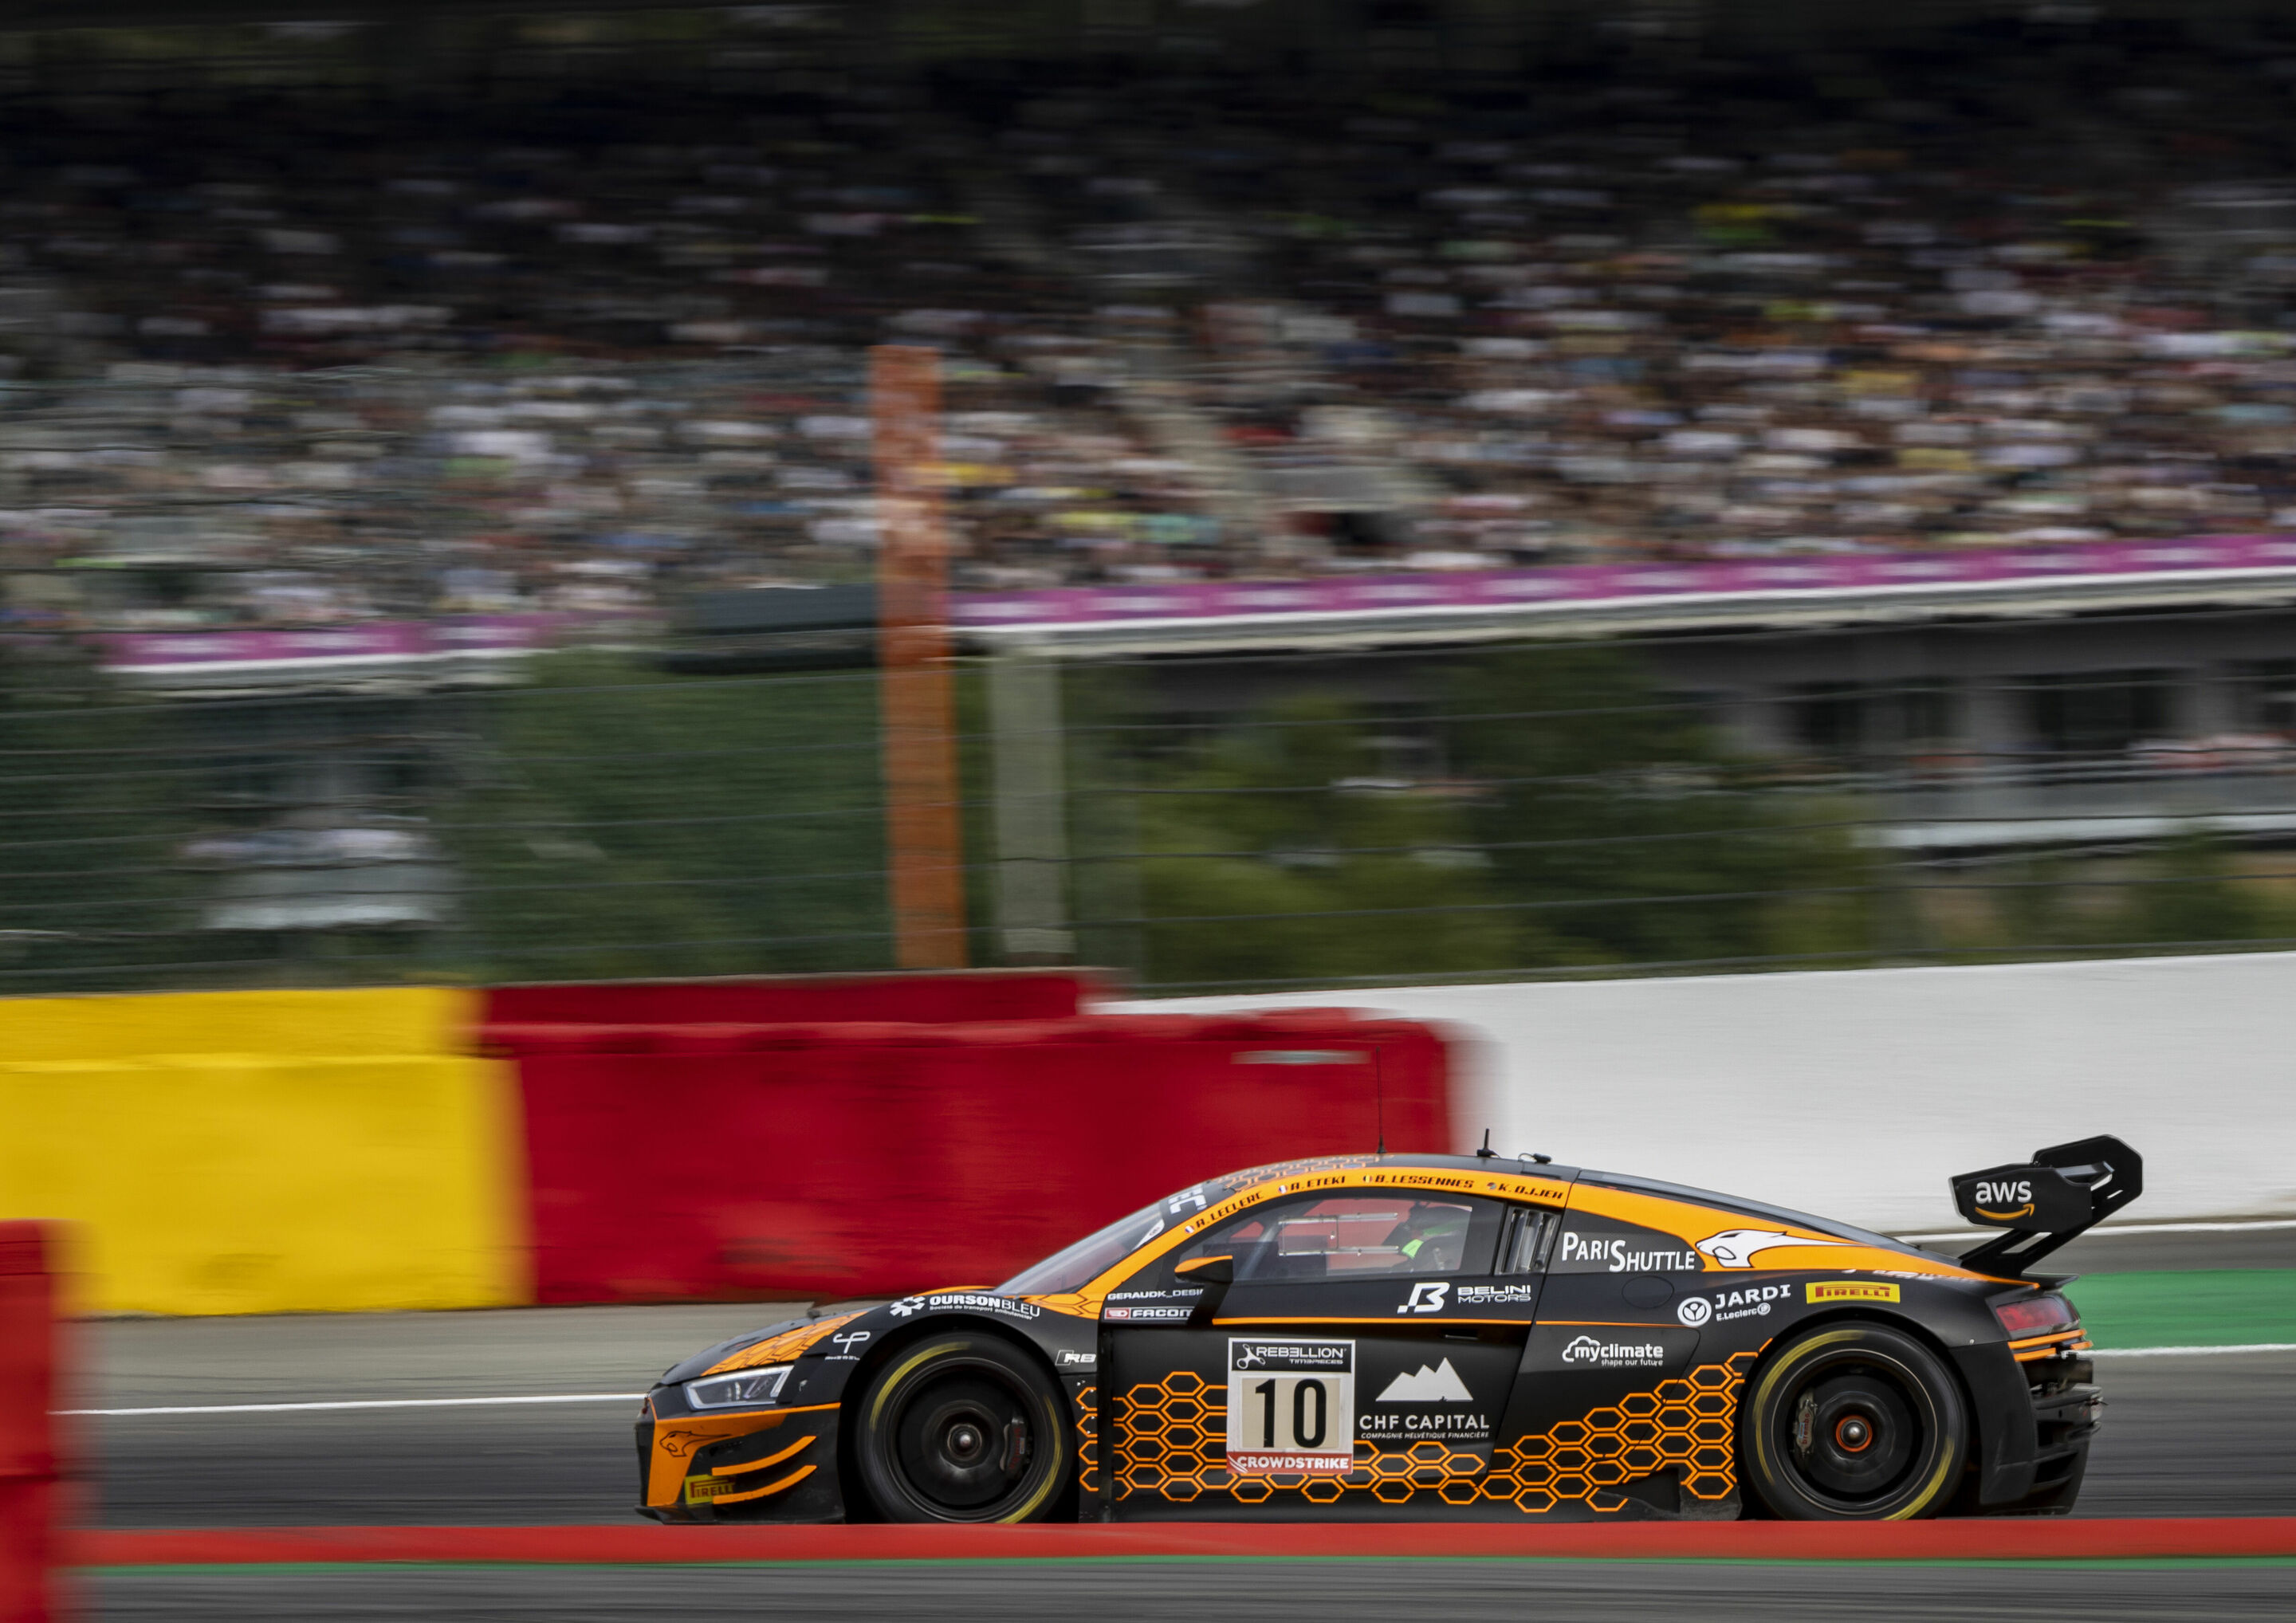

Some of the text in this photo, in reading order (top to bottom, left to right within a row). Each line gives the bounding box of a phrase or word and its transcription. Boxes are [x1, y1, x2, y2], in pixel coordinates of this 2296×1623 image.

[1307, 1176, 1345, 1188] ETEKI
[1391, 1175, 1474, 1189] LESSENNES
[1976, 1181, 2032, 1204] aws
[1457, 1285, 1531, 1295] BELINI
[1815, 1287, 1890, 1298] PIRELLI
[1458, 1295, 1531, 1303] MOTORS
[1715, 1284, 1791, 1310] JARDI
[1256, 1346, 1344, 1358] REBELLION
[1575, 1343, 1664, 1362] myclimate
[1601, 1358, 1623, 1367] shape
[1256, 1378, 1327, 1448] 10
[1358, 1414, 1490, 1430] CHF CAPITAL
[1236, 1456, 1349, 1469] CROWDSTRIKE
